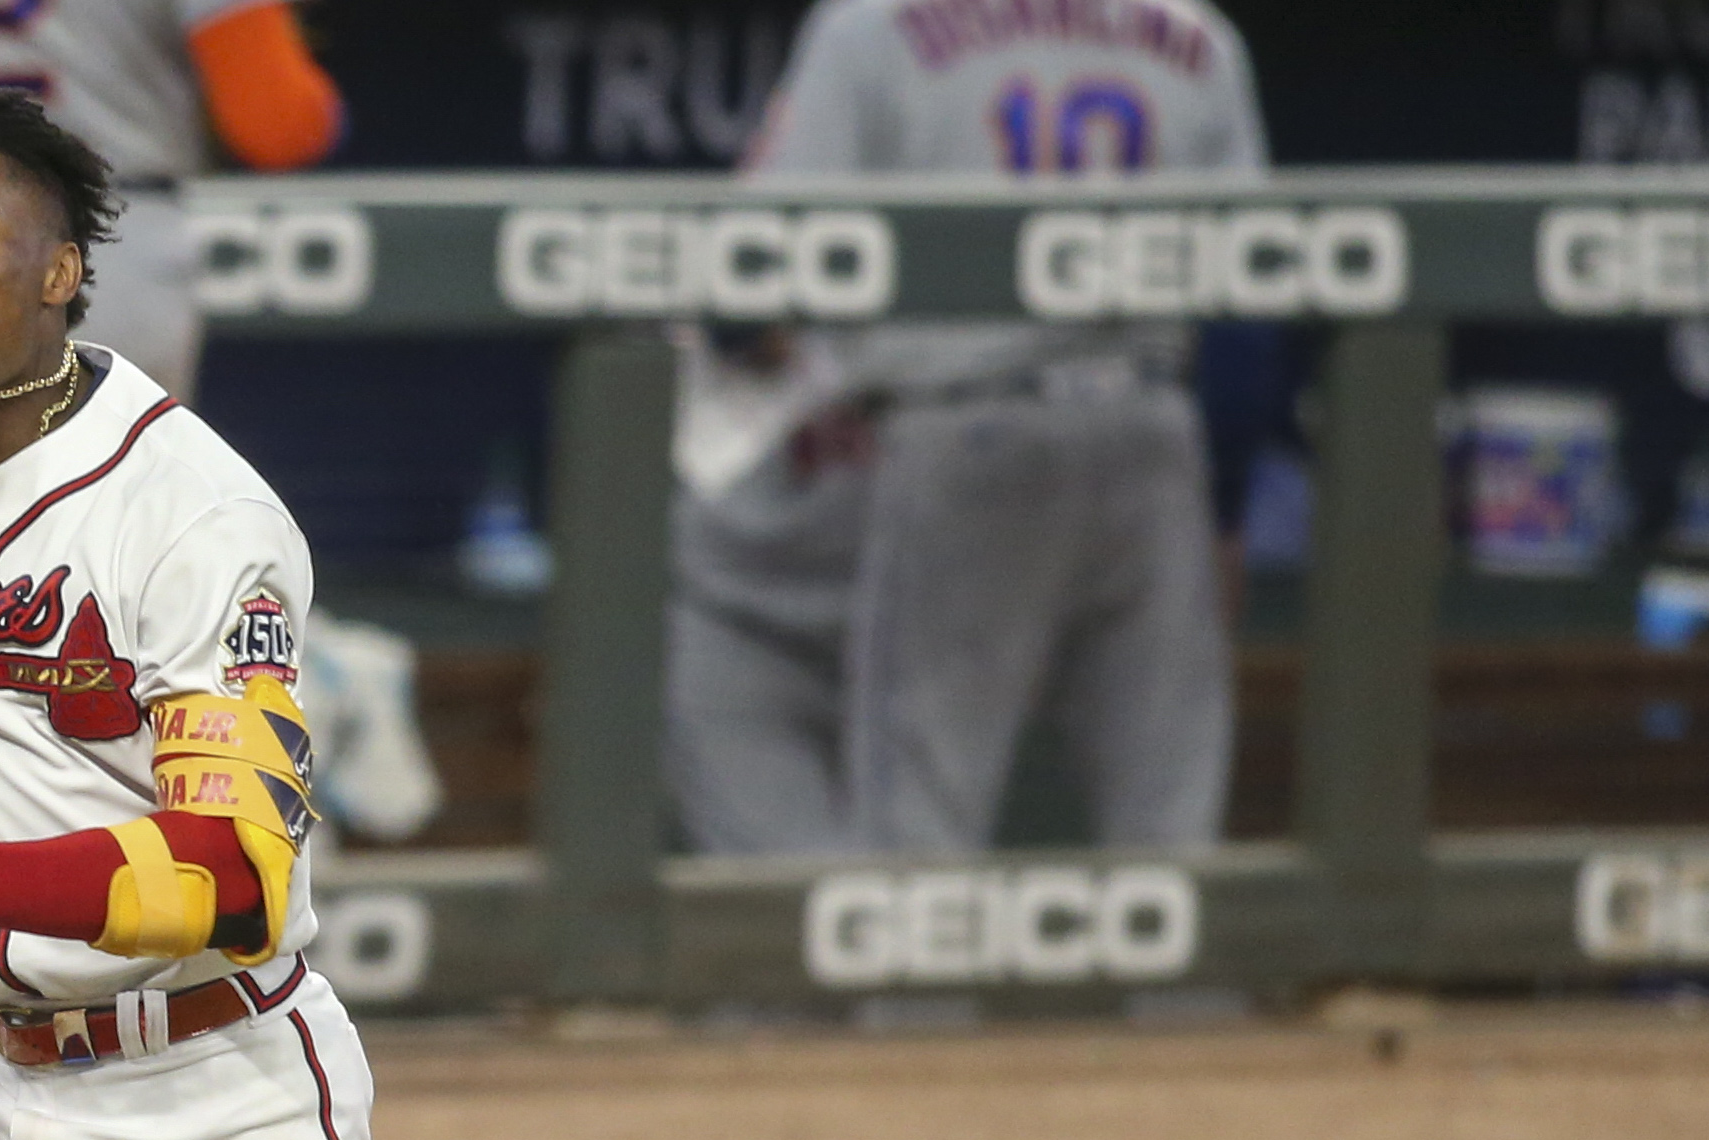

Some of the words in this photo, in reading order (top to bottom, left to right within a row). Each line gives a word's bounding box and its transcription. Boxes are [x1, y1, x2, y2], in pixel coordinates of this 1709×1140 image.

[495, 208, 892, 320] GEICO
[1016, 207, 1411, 317] GEICO
[235, 614, 290, 665] 150
[188, 710, 243, 747] JR.
[190, 771, 240, 805] JR.
[801, 869, 1196, 985] GEICO
